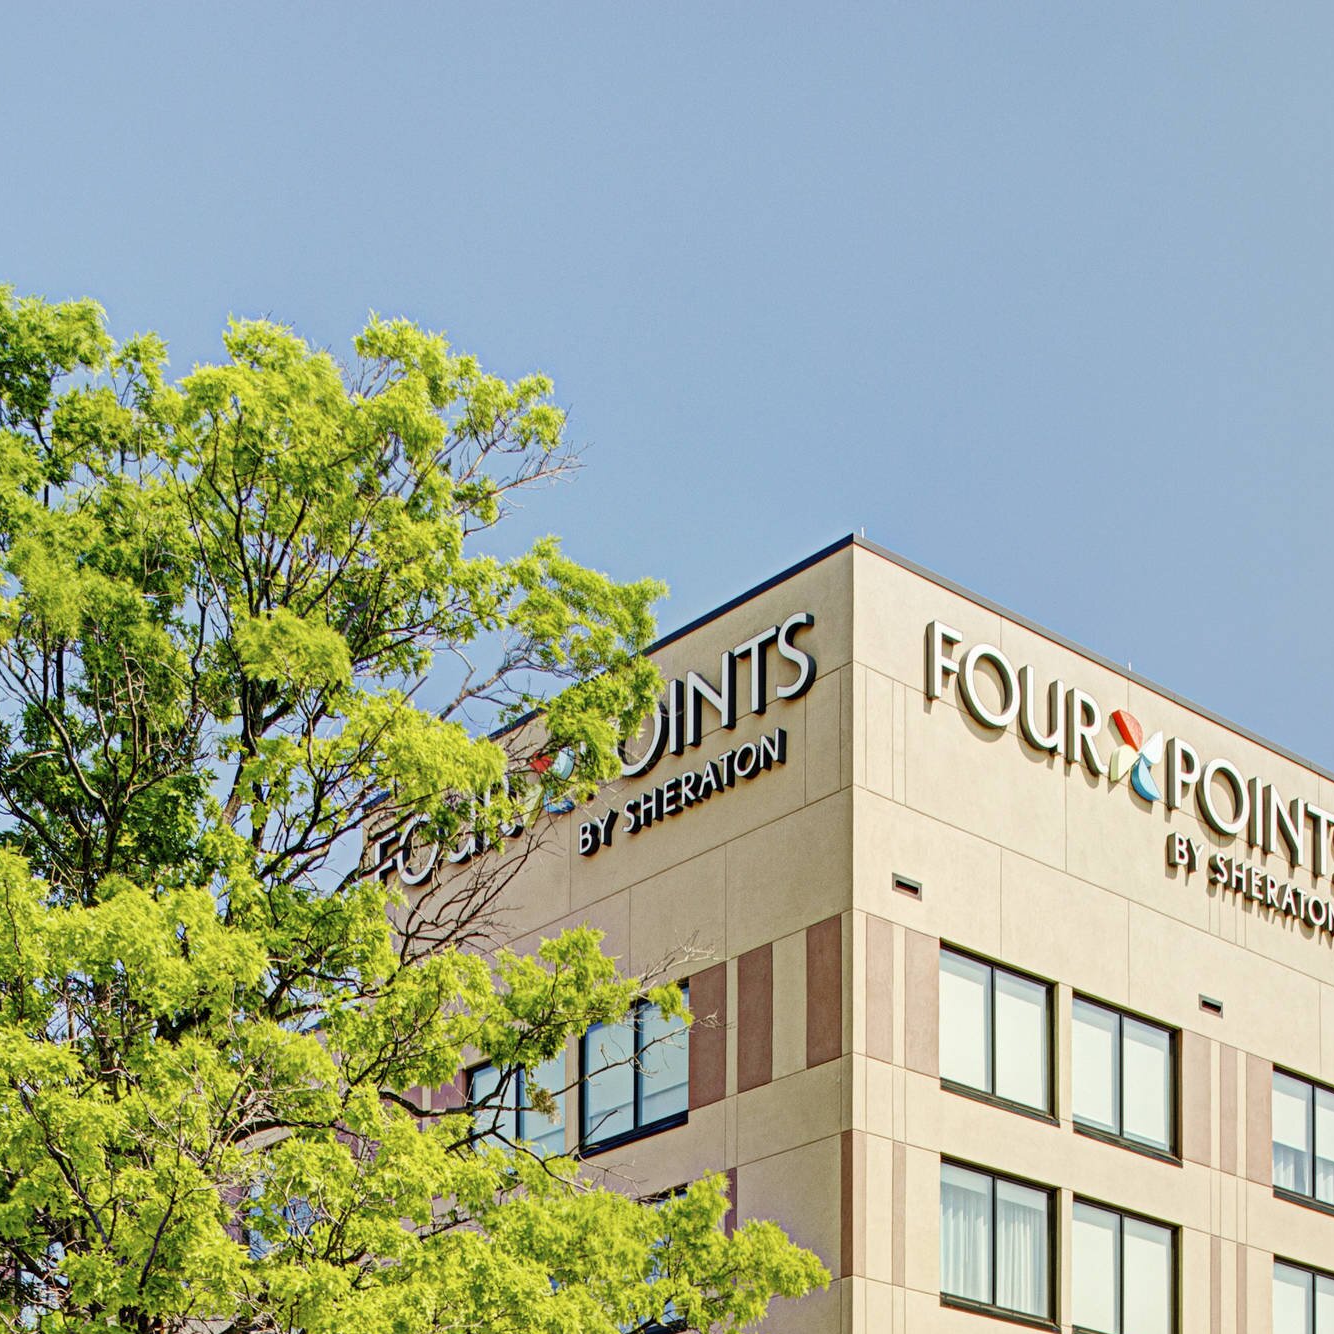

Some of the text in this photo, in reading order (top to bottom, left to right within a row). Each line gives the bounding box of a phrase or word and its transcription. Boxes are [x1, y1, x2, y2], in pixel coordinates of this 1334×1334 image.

[580, 612, 816, 778] OINTS
[924, 619, 1109, 777] FOUR
[578, 727, 787, 856] BY SHERATON
[1167, 831, 1205, 873] BY
